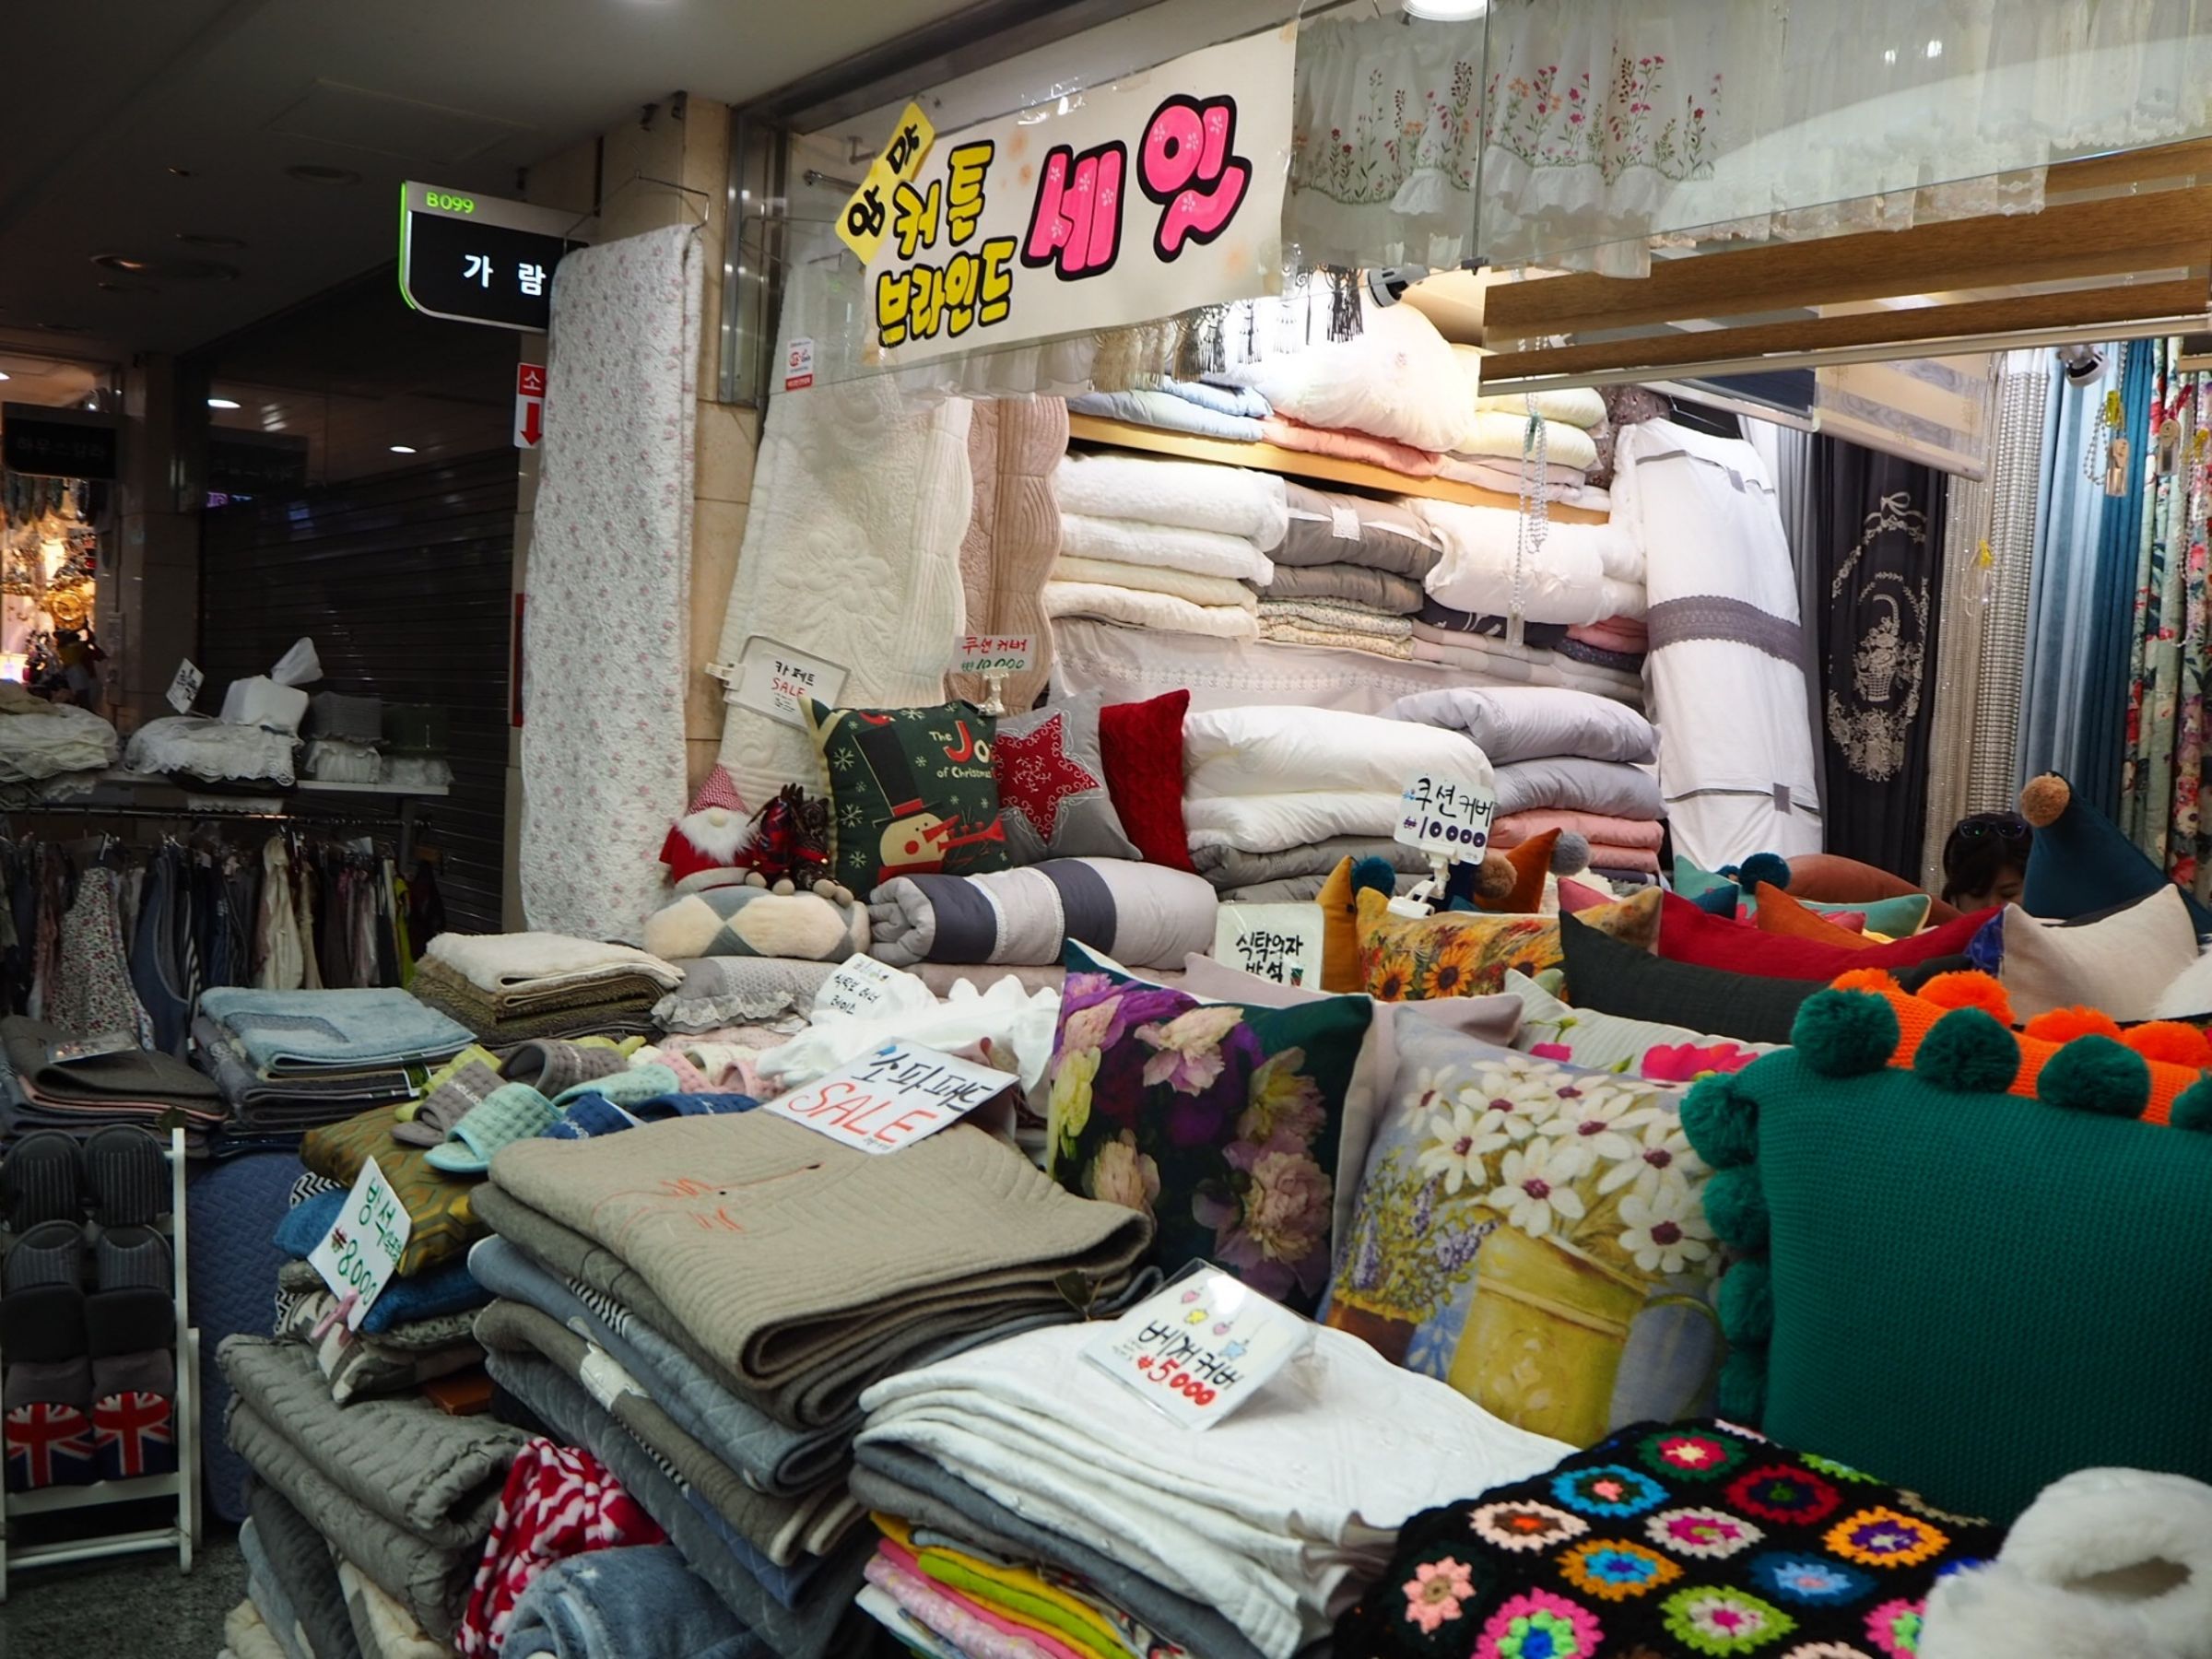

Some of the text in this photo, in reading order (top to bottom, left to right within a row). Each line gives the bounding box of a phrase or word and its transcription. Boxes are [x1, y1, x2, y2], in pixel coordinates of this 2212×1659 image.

[427, 192, 475, 214] B099
[893, 139, 994, 260] 커튼
[1020, 93, 1253, 281] 세일
[877, 236, 1018, 348] 브라인드
[523, 371, 541, 391] 소
[771, 677, 806, 698] SALE
[929, 731, 953, 742] The
[943, 720, 991, 764] Jo
[936, 766, 993, 779] of Christma
[788, 1081, 938, 1144] SALE
